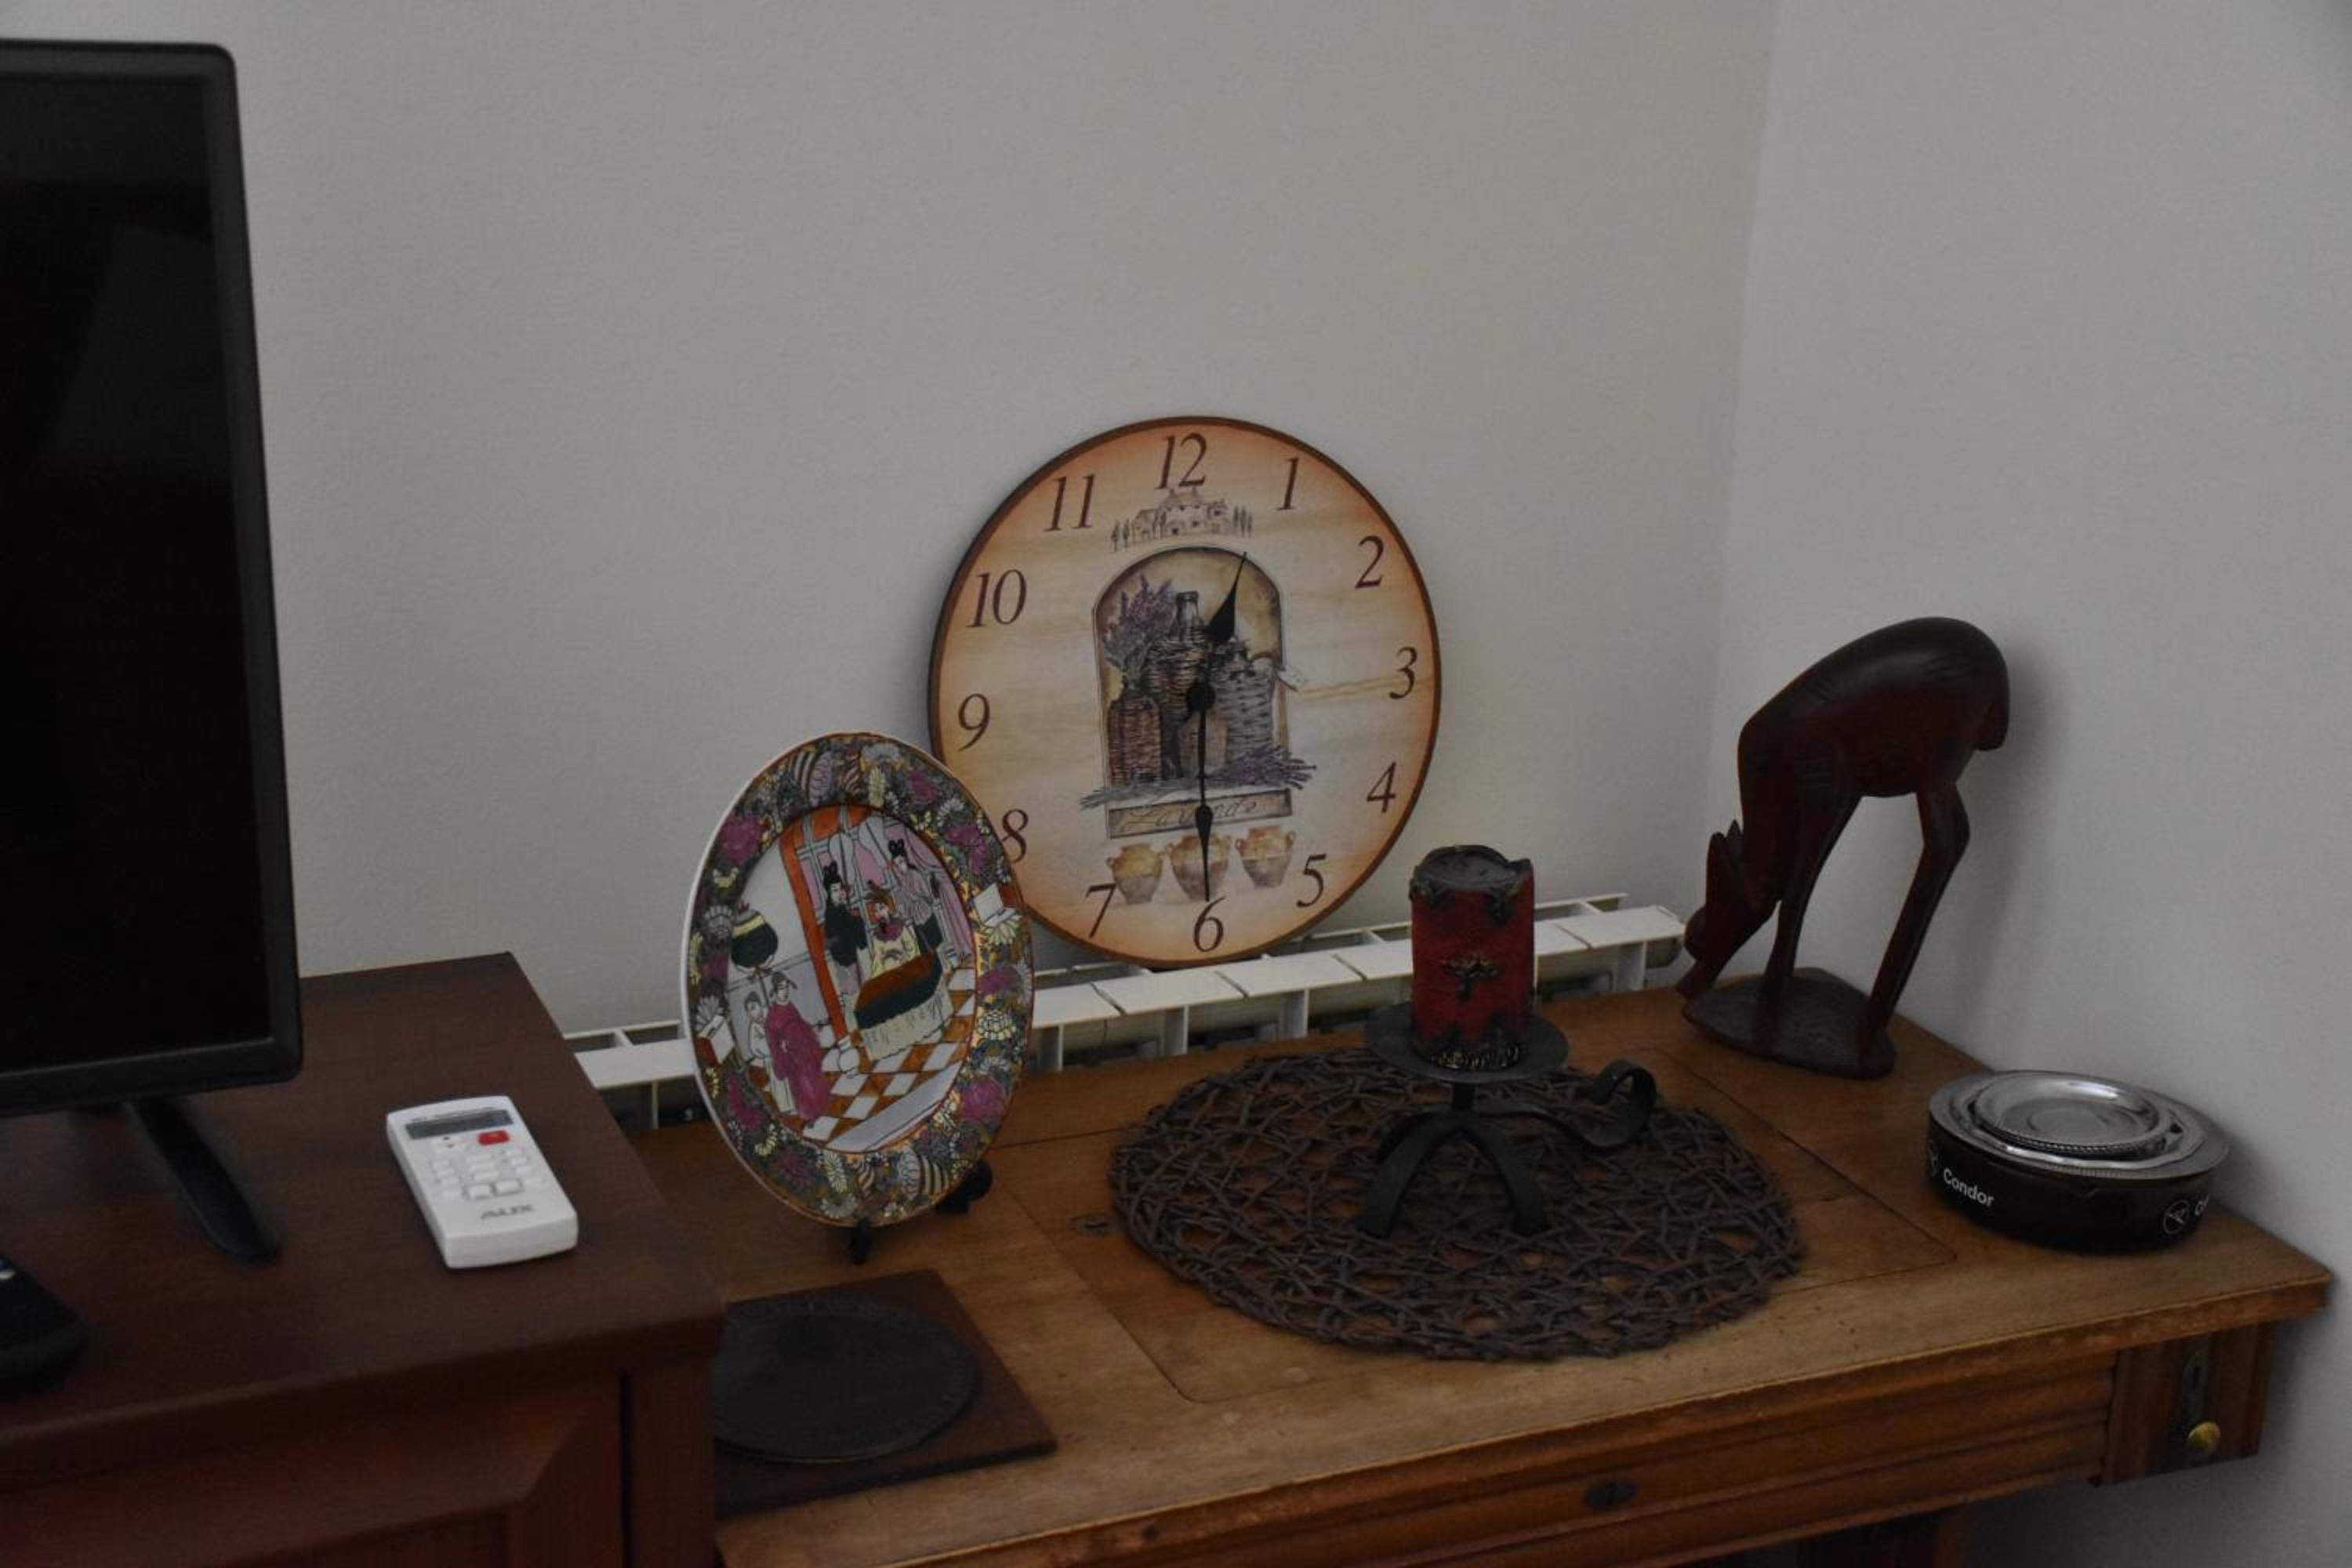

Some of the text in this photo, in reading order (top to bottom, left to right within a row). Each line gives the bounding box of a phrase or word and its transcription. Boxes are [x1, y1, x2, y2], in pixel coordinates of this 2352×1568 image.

[1155, 433, 1208, 489] 12
[1277, 457, 1299, 510] 1
[1044, 474, 1096, 531] 11
[1355, 535, 1384, 589] 2
[967, 569, 1027, 628] 10
[1388, 647, 1417, 699] 3
[957, 693, 991, 751] 9
[1367, 762, 1396, 813] 4
[1002, 809, 1029, 863] 8
[1296, 854, 1327, 907] 5
[1085, 884, 1117, 938] 7
[1192, 898, 1225, 952] 6
[1943, 1167, 1994, 1207] Condor
